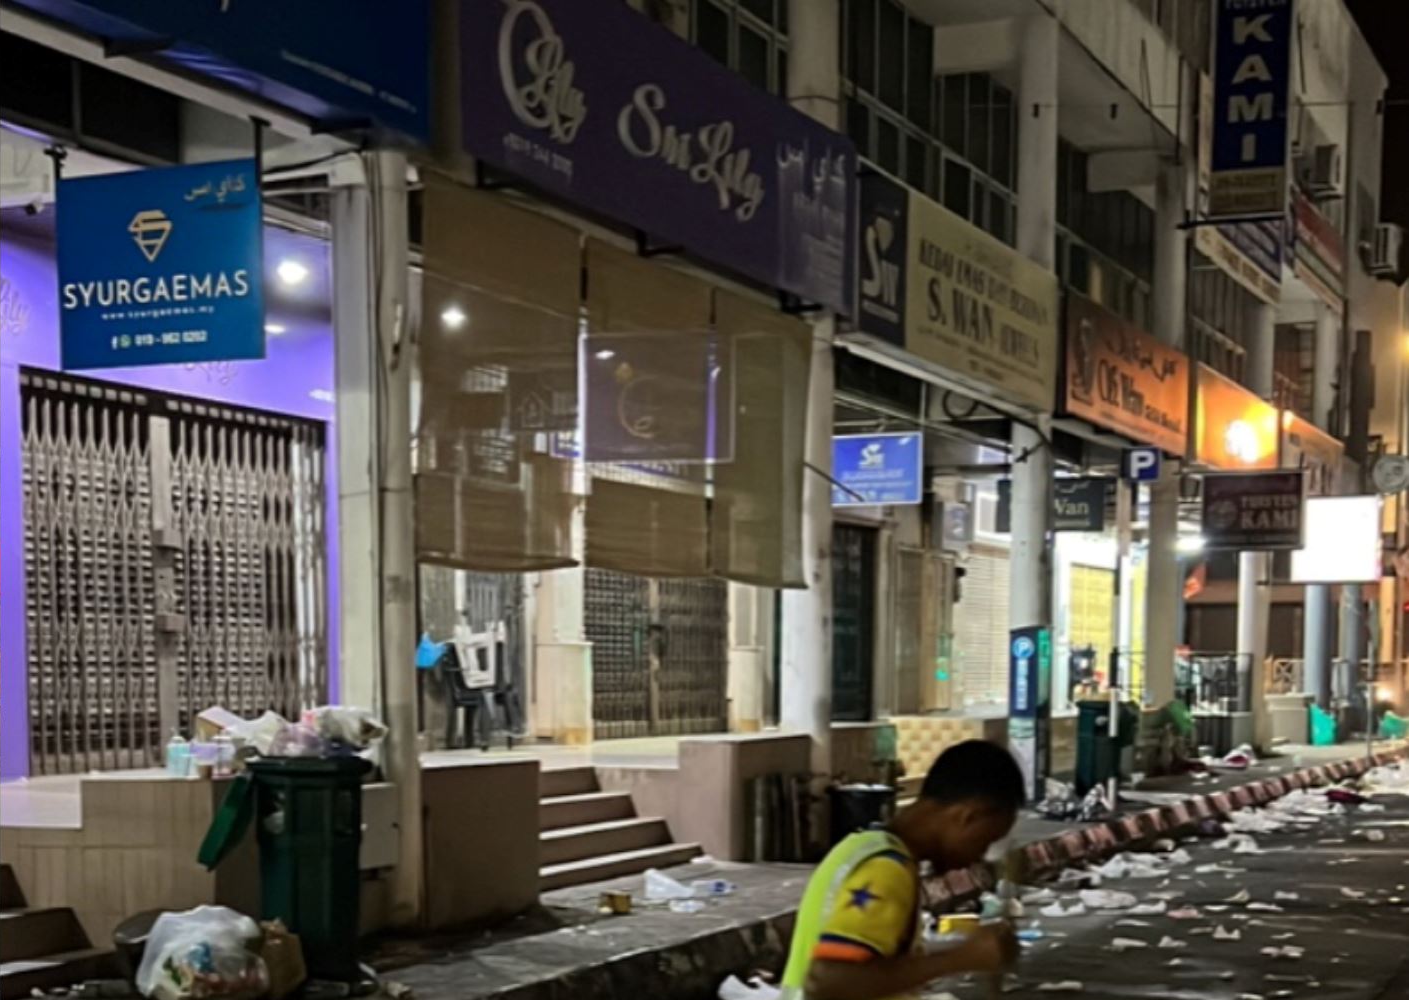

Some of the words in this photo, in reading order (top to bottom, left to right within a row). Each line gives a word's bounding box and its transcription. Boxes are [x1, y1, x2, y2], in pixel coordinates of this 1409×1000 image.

[1227, 13, 1274, 162] KAMI
[63, 270, 249, 310] SYURGAEMAS
[951, 287, 994, 345] WAN
[1129, 451, 1155, 478] P
[1241, 510, 1298, 529] KAMI
